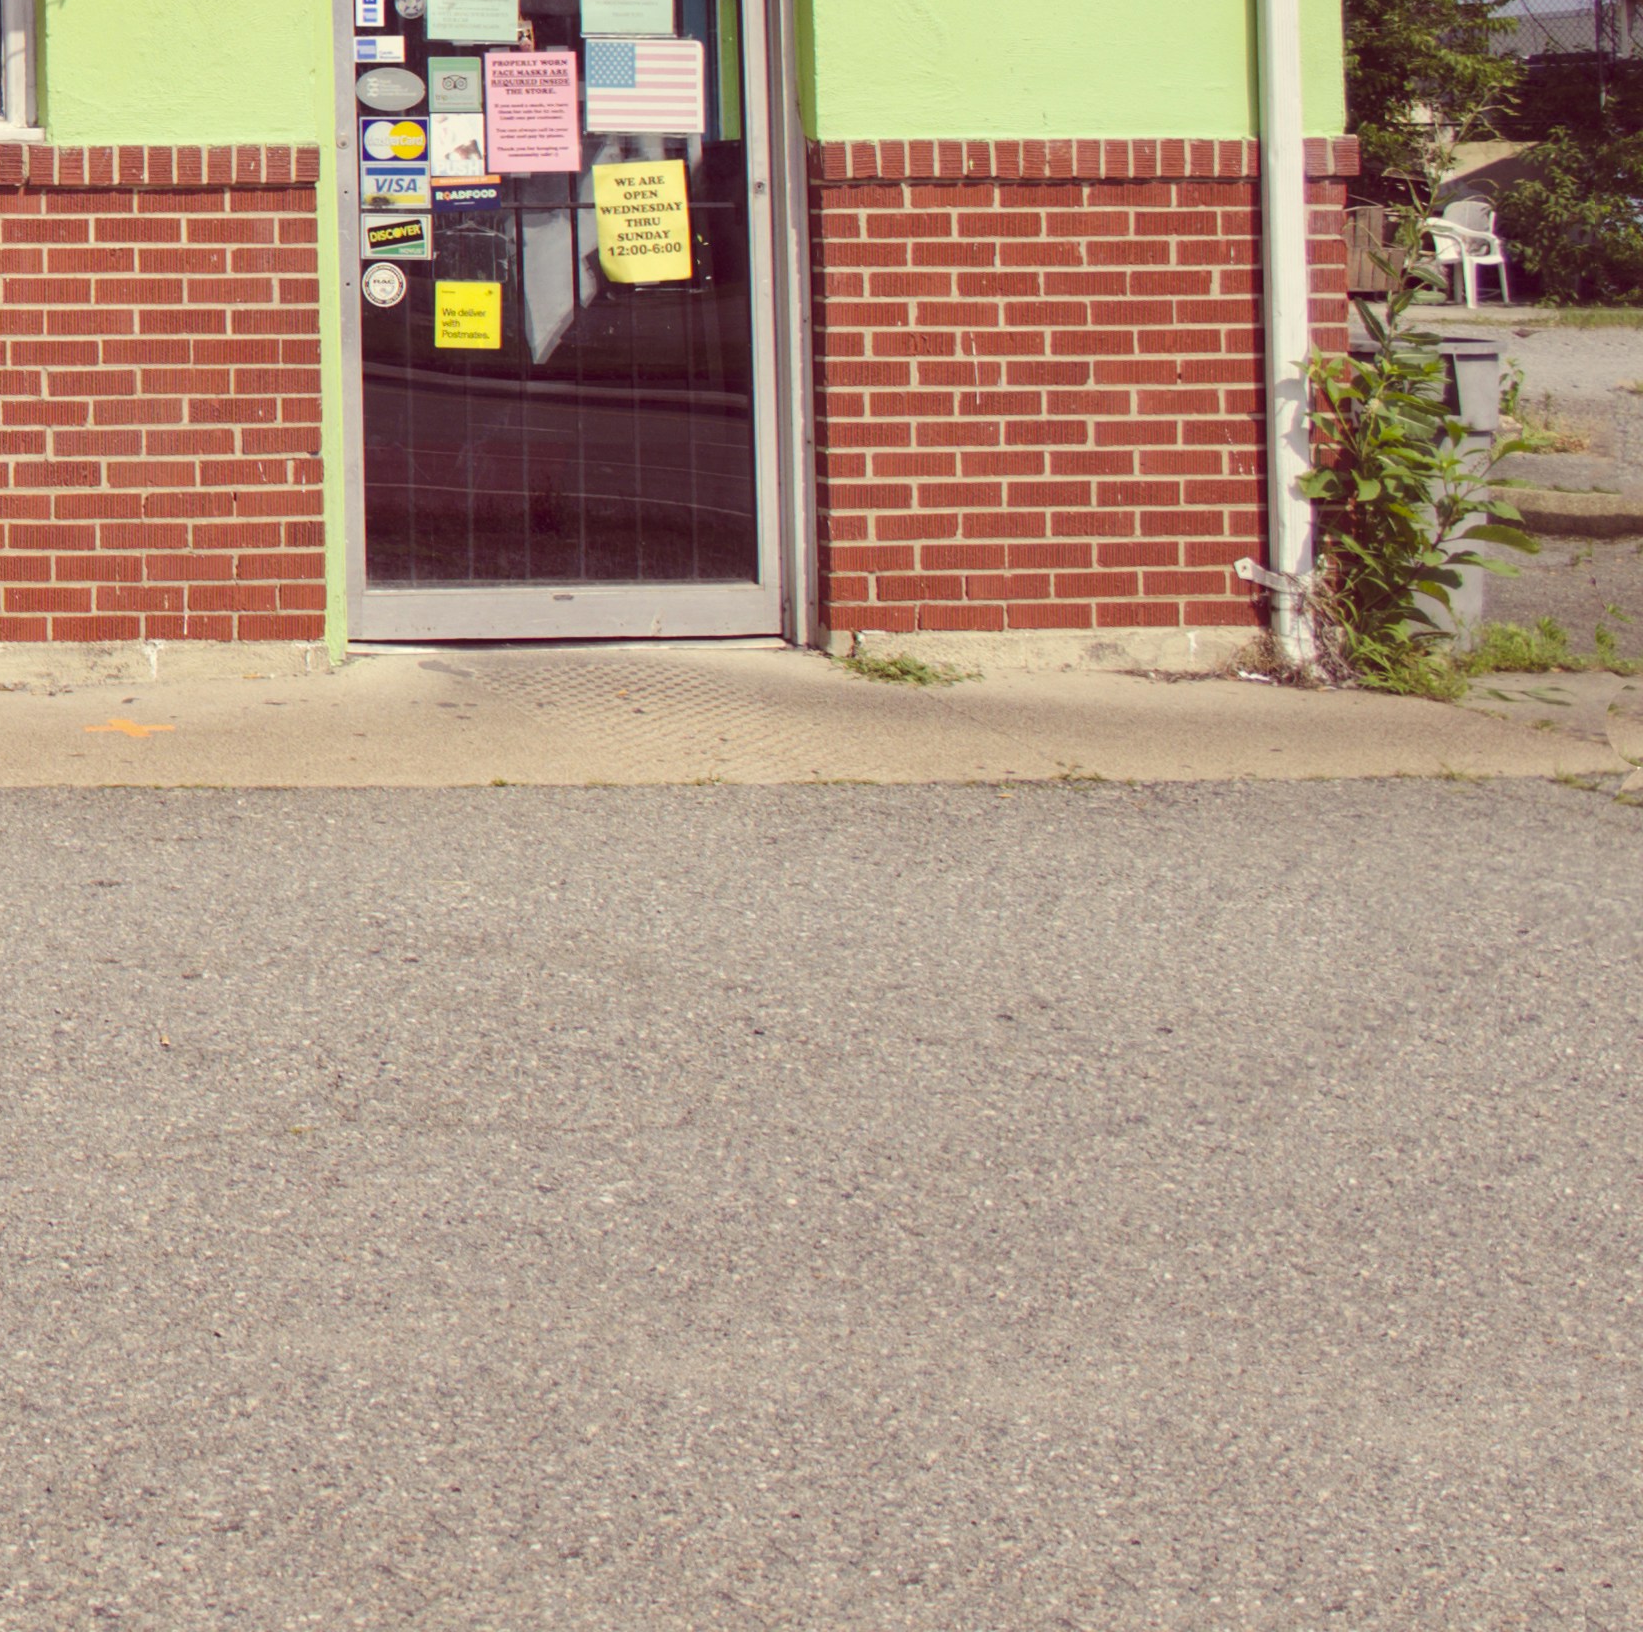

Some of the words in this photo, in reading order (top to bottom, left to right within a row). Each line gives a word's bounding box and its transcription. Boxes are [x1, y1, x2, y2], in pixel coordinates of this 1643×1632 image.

[375, 178, 417, 192] VISA
[614, 177, 635, 186] WE
[639, 176, 665, 185] ARE
[435, 188, 497, 200] ROADFOOD
[623, 190, 658, 200] OPEN
[600, 202, 682, 215] WEDNESDAY
[625, 217, 660, 227] THRU
[369, 224, 421, 242] DISCOVER
[617, 230, 670, 242] SUNDAY
[608, 242, 681, 256] 12:00-6:00
[458, 308, 486, 317] deliver
[442, 319, 460, 327] with
[442, 330, 490, 339] Postmates.
